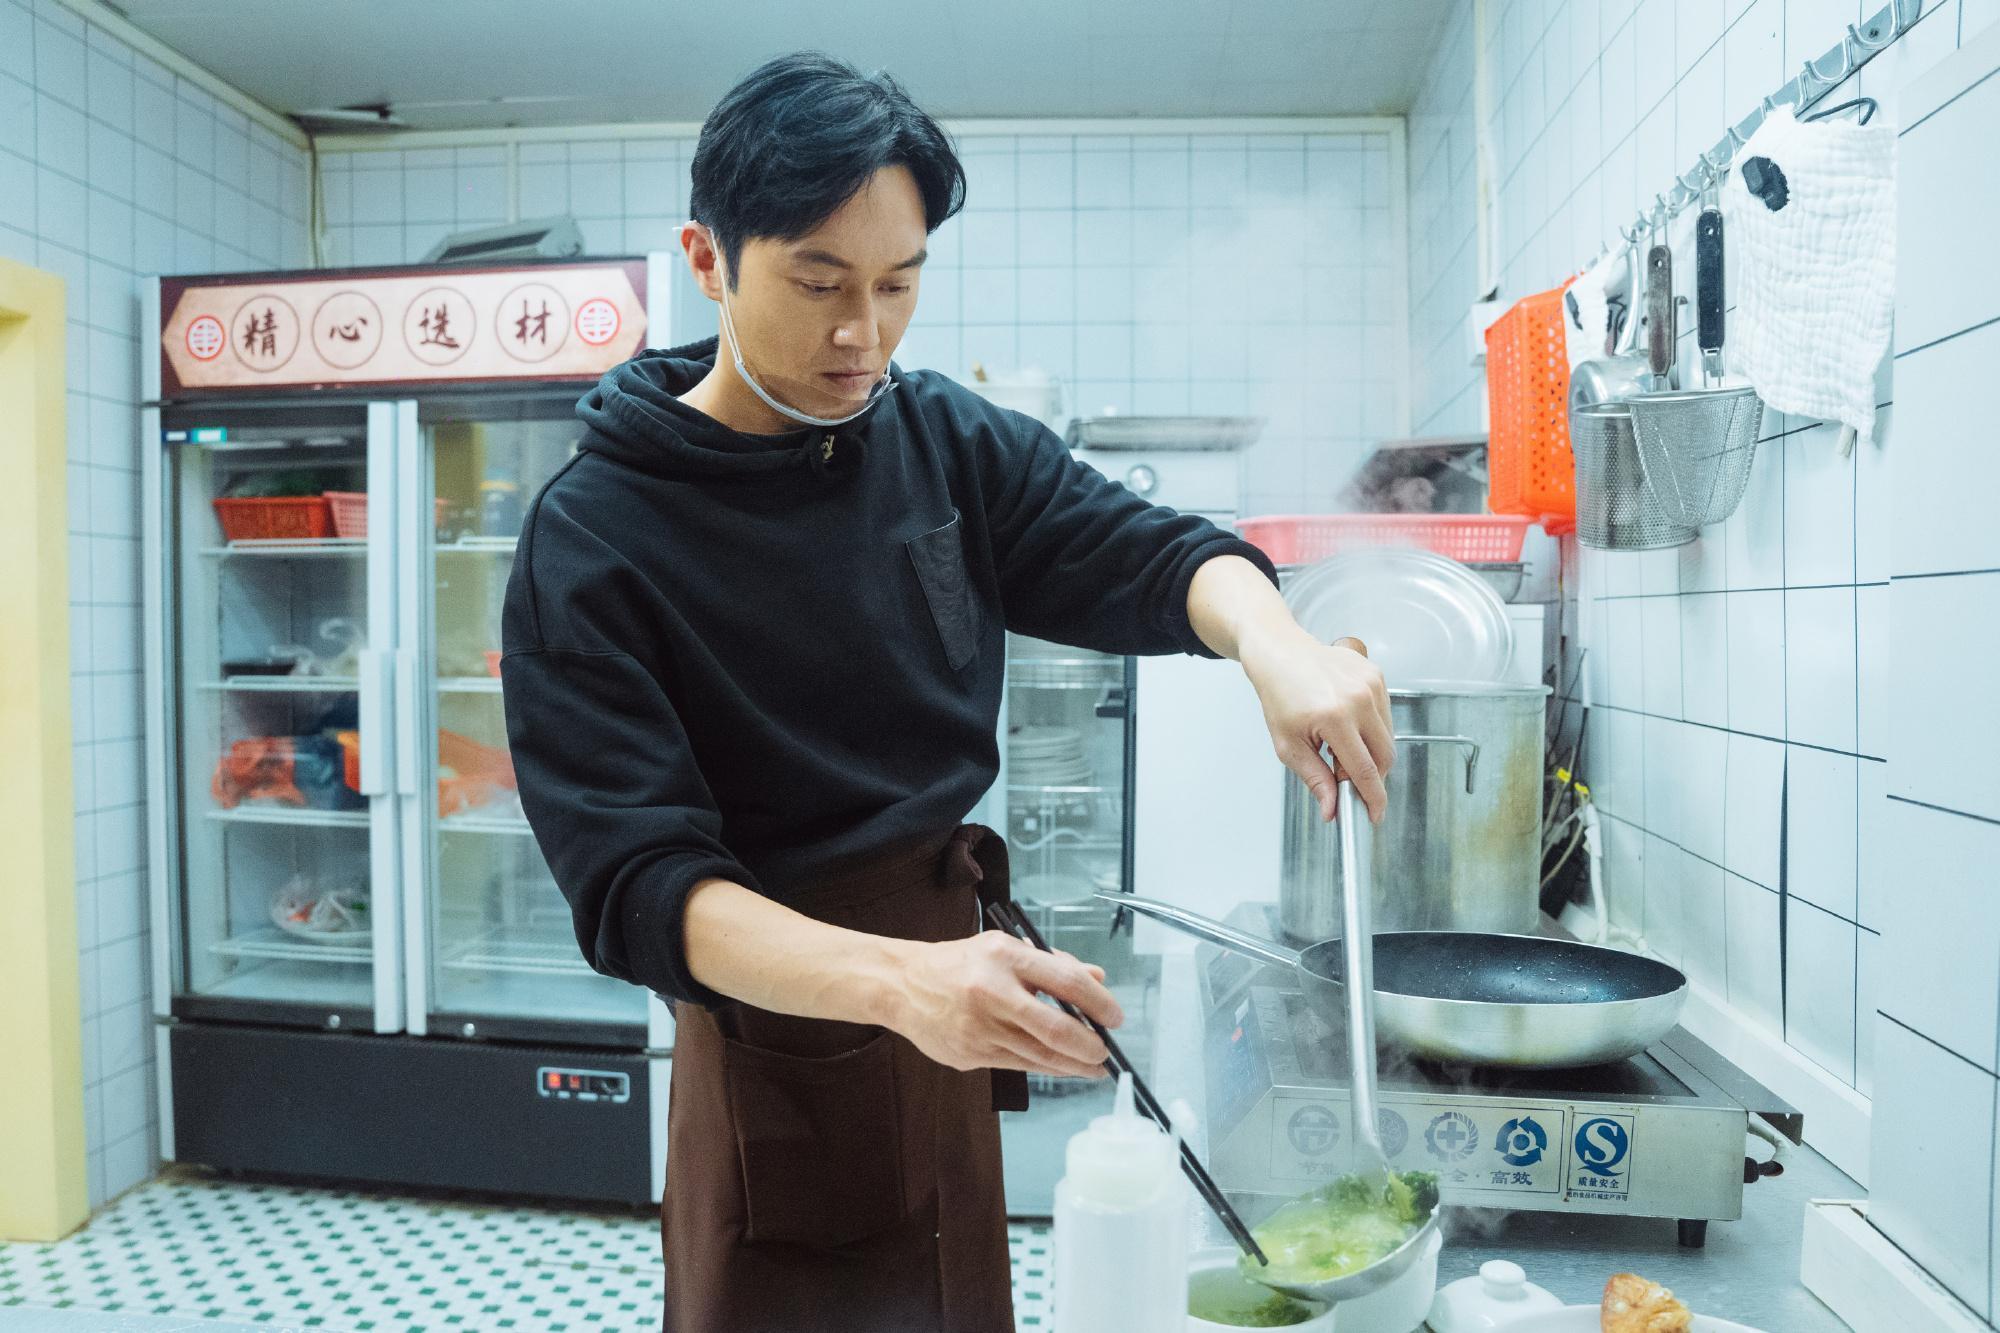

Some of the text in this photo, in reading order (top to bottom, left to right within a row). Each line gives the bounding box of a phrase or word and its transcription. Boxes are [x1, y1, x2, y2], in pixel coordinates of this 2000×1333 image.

[243, 298, 552, 357] 精心选材
[1578, 1176, 1619, 1189] 质量安全
